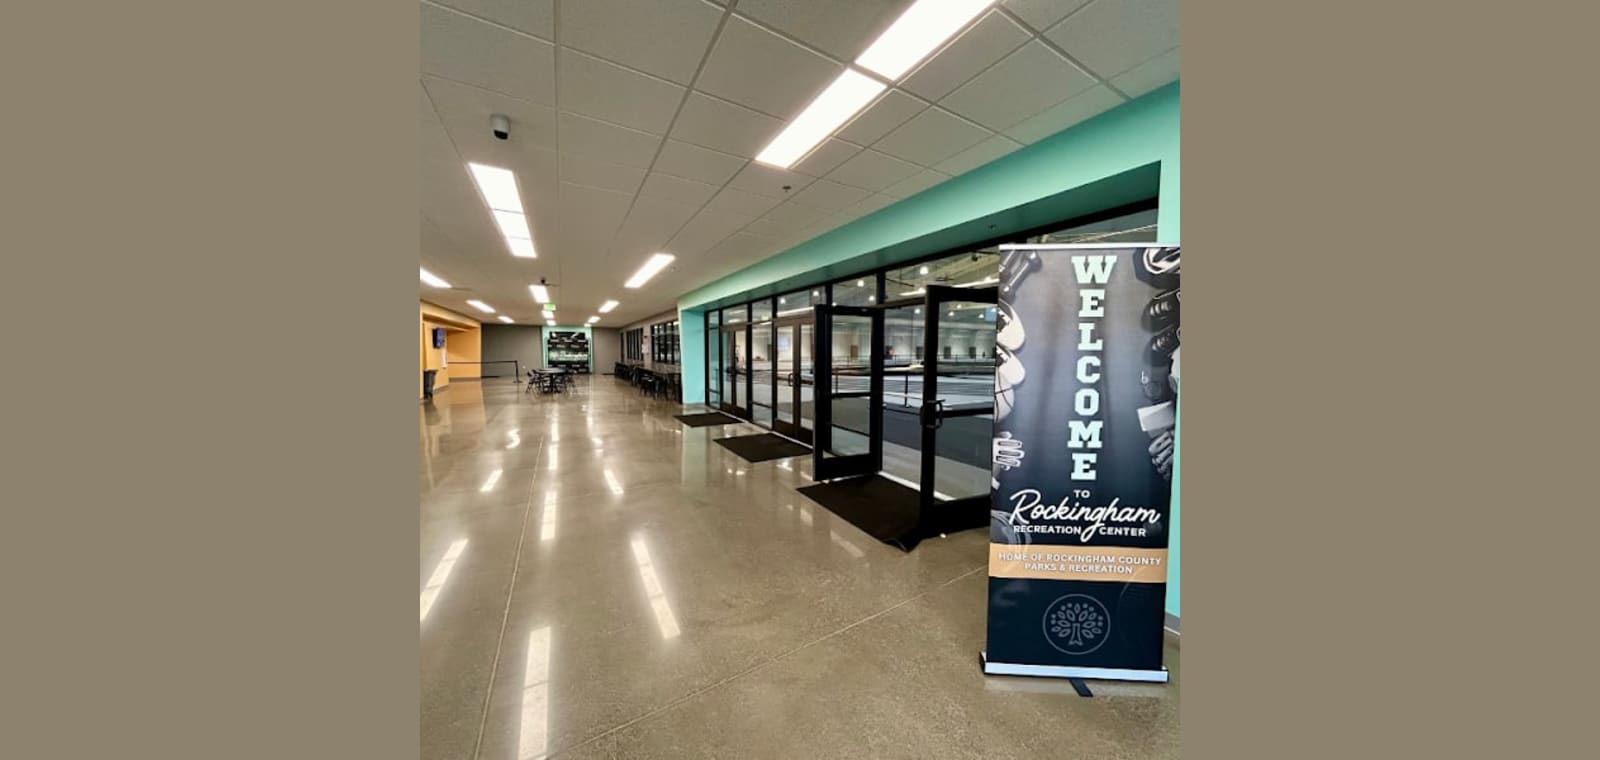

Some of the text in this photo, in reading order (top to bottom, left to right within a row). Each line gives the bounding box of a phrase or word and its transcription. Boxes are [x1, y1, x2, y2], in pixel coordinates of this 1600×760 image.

[1067, 255, 1118, 480] WELCOME
[1073, 489, 1090, 498] TO
[1009, 489, 1161, 542] Rockingham
[1013, 525, 1146, 537] RECREATION CENTER
[999, 553, 1161, 566] HOME OF ROCKINGHAM COUNTY
[1024, 563, 1057, 571] PARKS
[1069, 564, 1133, 574] RECREATION
